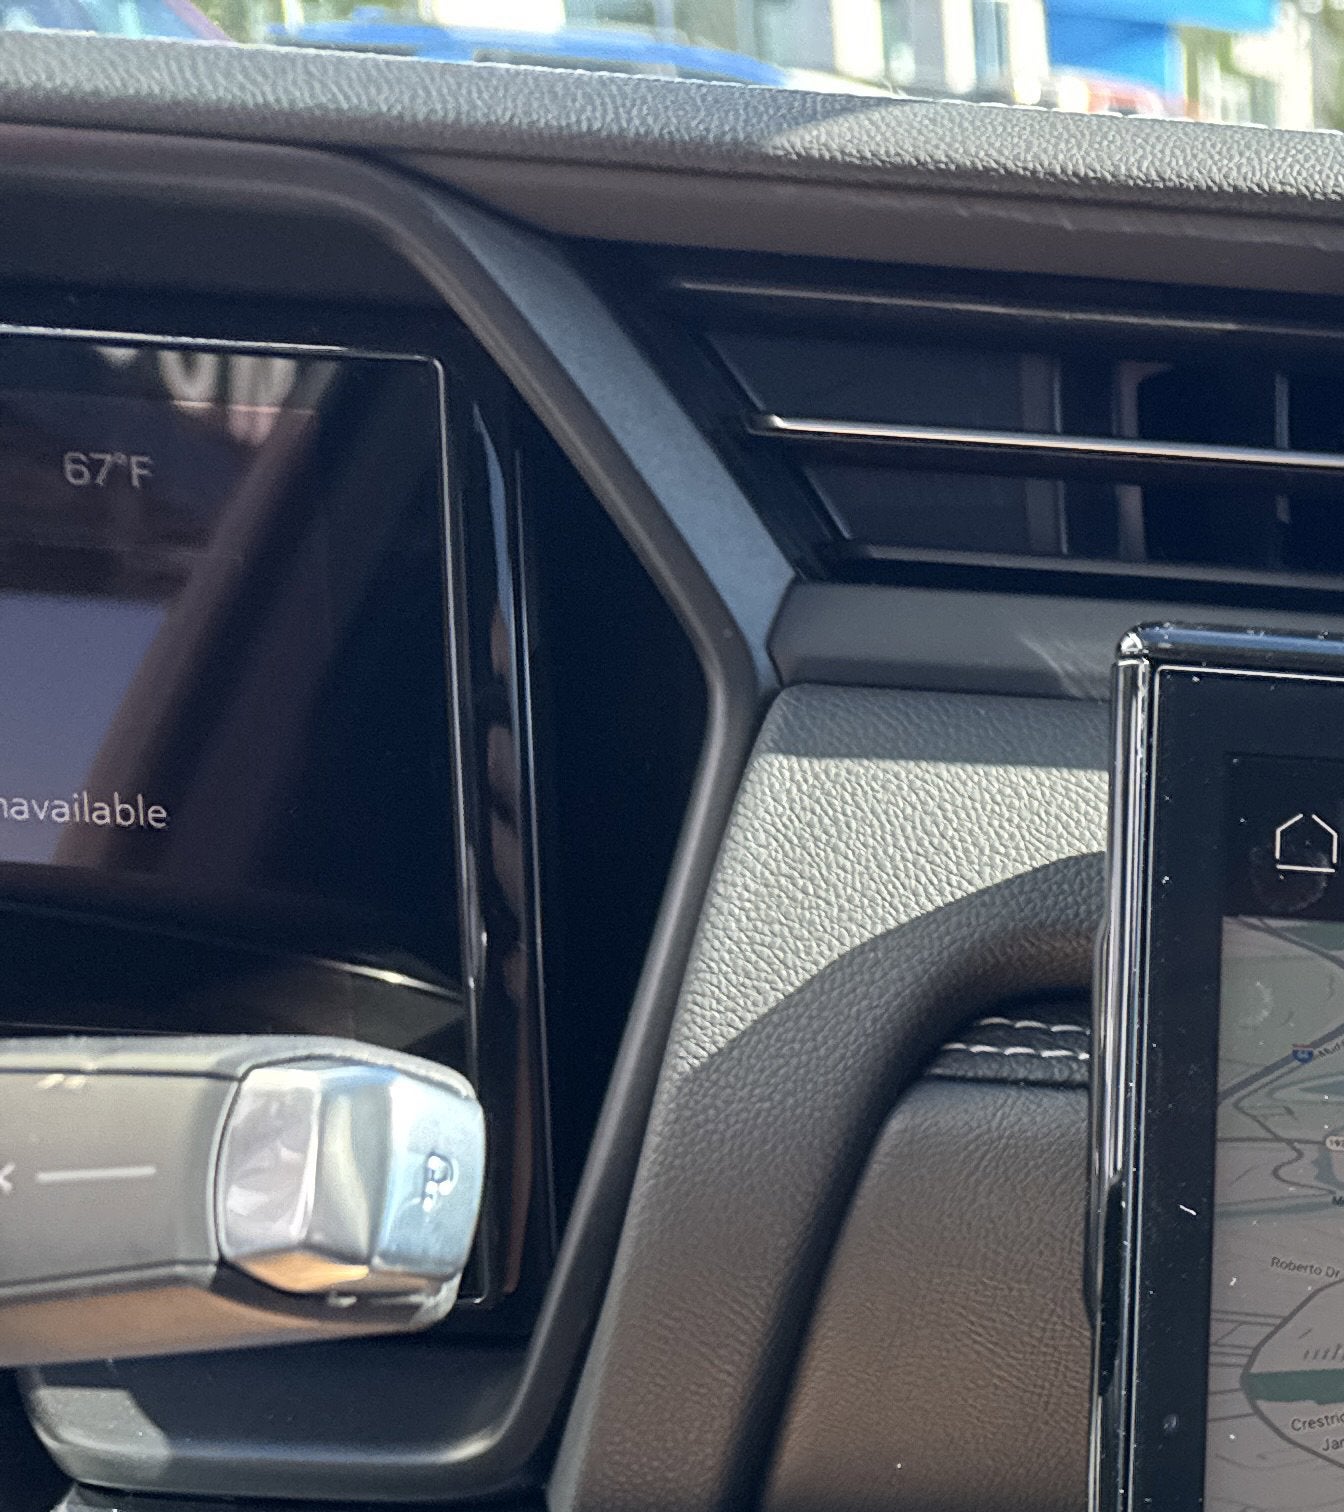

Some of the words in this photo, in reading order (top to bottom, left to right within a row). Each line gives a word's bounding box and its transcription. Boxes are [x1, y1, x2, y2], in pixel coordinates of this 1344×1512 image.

[63, 451, 154, 488] 67°F
[1270, 1256, 1322, 1279] Roberto
[1325, 1264, 1340, 1279] Dr
